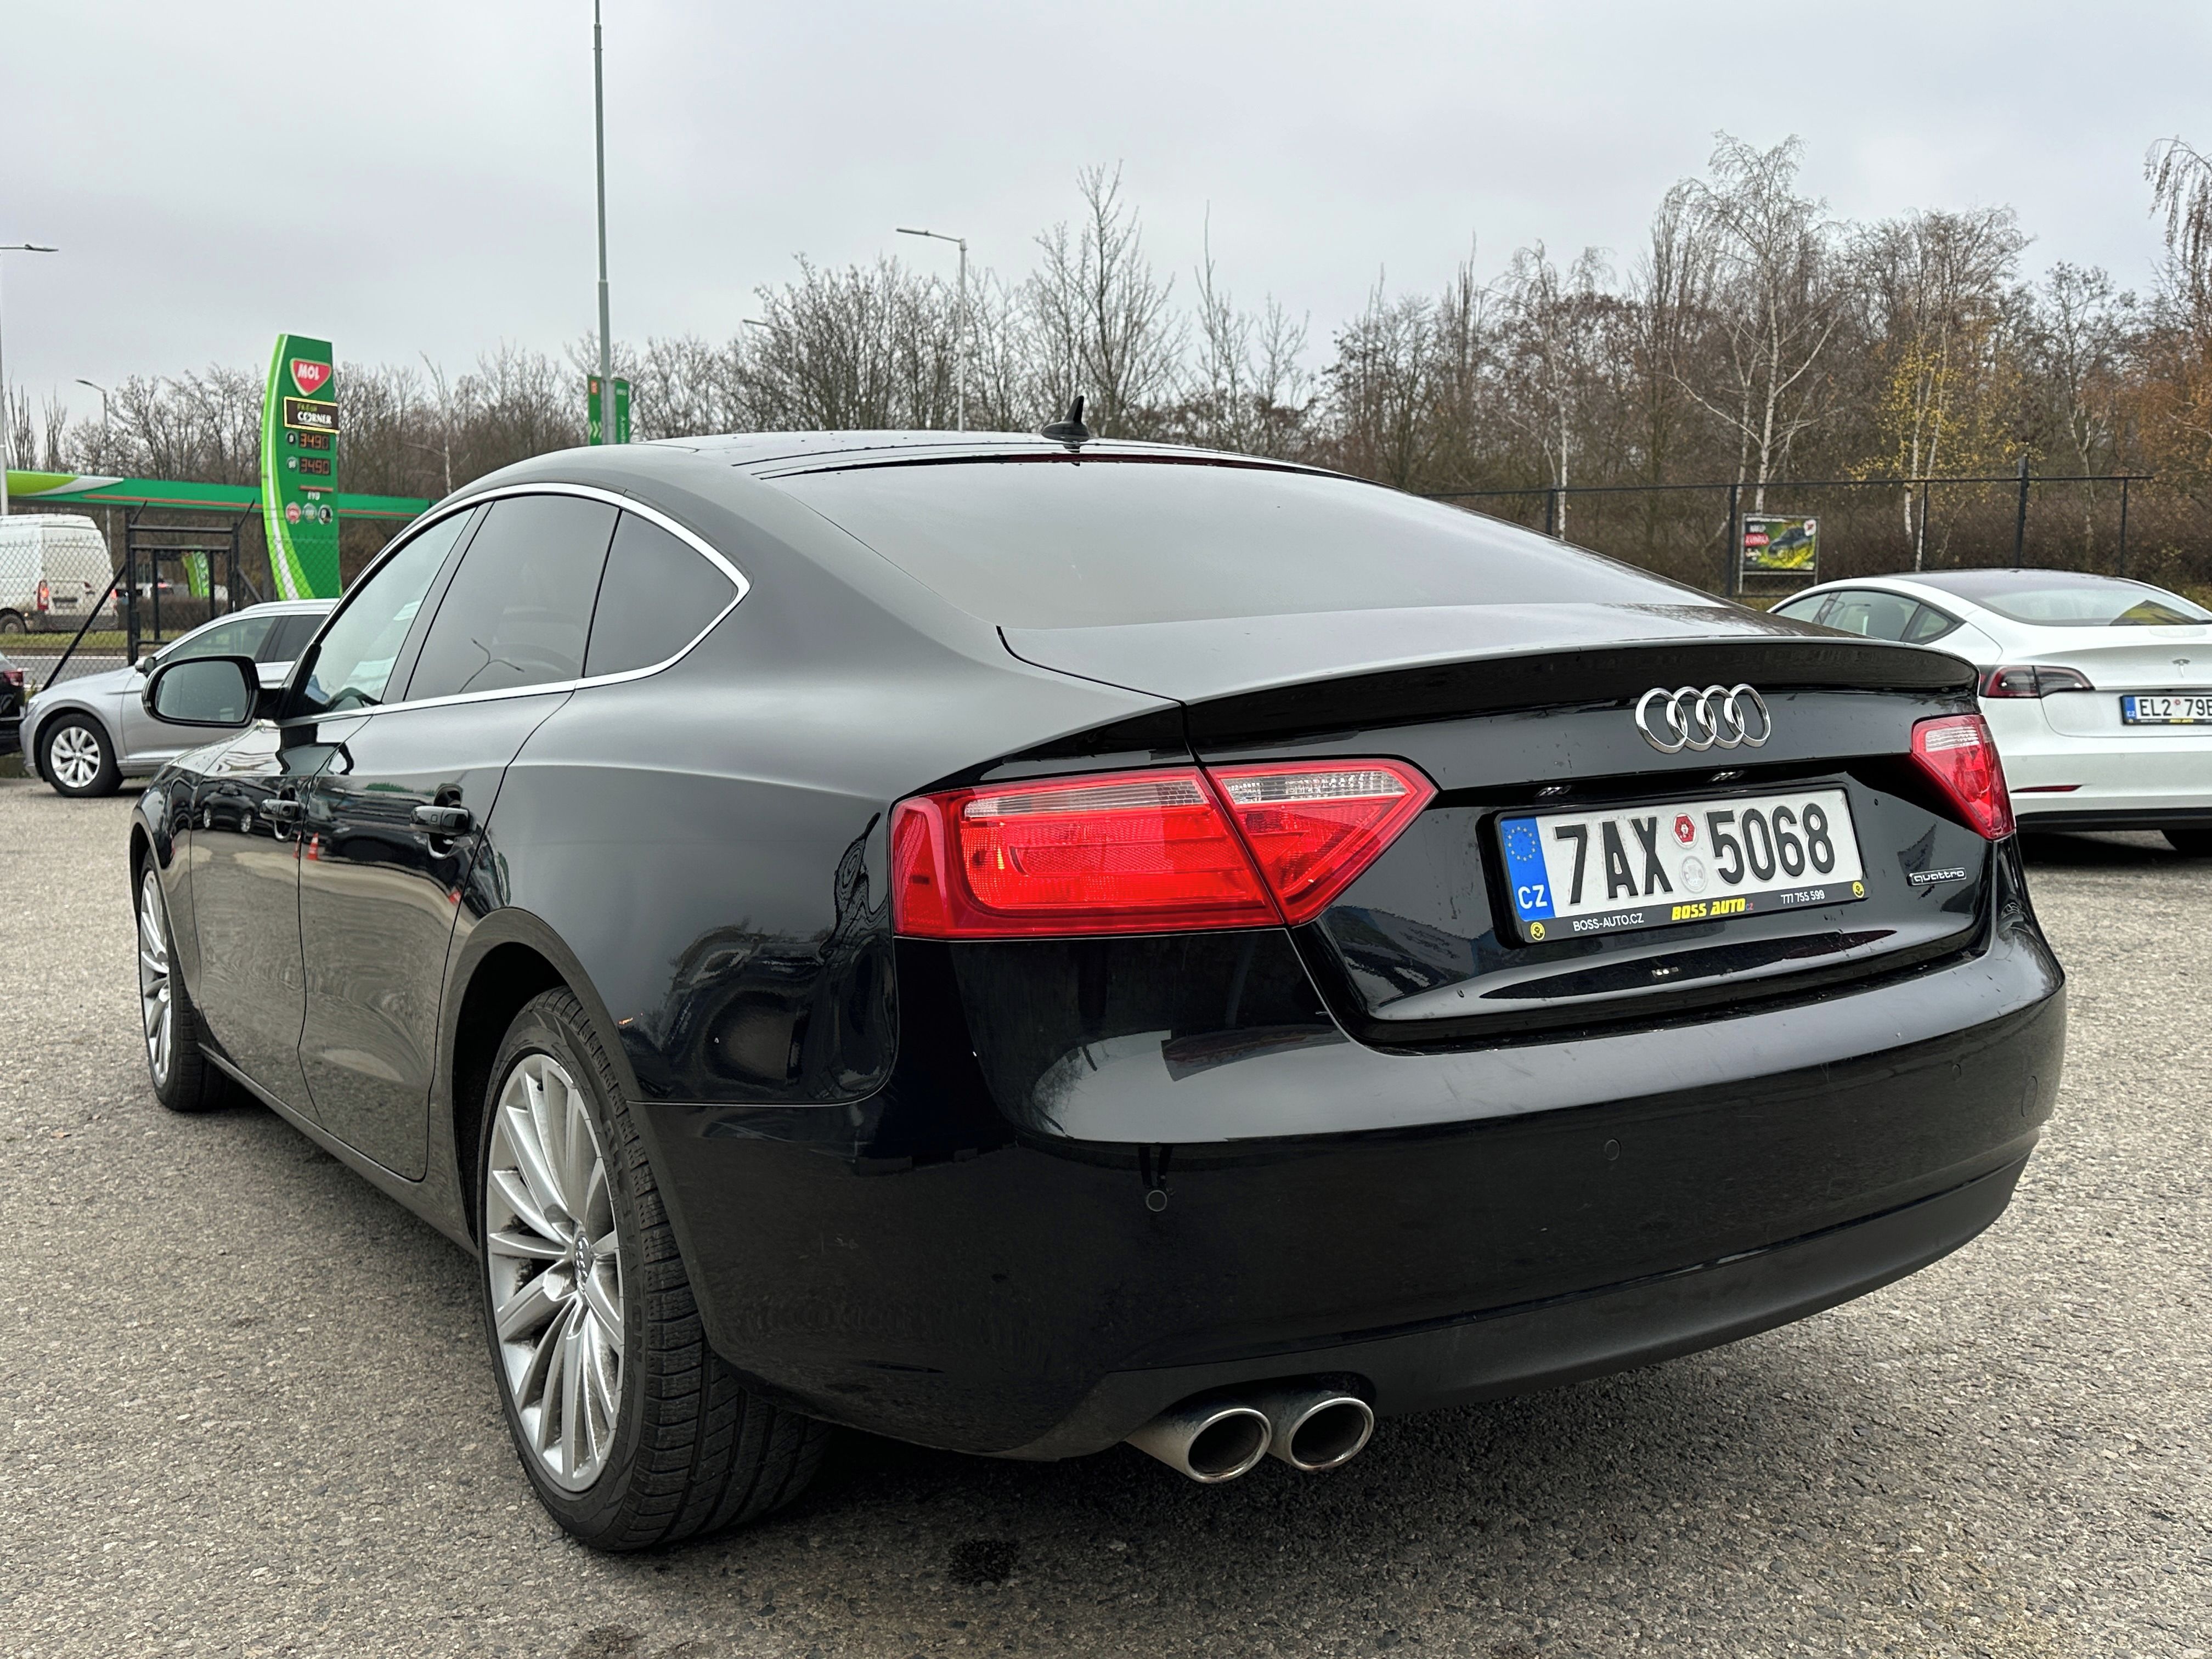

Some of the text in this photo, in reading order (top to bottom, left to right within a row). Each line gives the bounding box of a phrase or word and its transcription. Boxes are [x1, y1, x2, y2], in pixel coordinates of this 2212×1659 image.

[297, 364, 320, 380] MOL
[297, 411, 332, 425] CORNER
[2139, 698, 2172, 716] EL2
[1554, 802, 1836, 905] 7AX 5068
[1914, 870, 1965, 883] quattro
[1518, 884, 1548, 910] CZ
[1794, 891, 1810, 902] 755
[1809, 889, 1825, 900] 599
[1671, 902, 1707, 921] BOSS
[1709, 898, 1746, 916] AUTO
[1573, 912, 1644, 932] BOSS-AUTO.CZ
